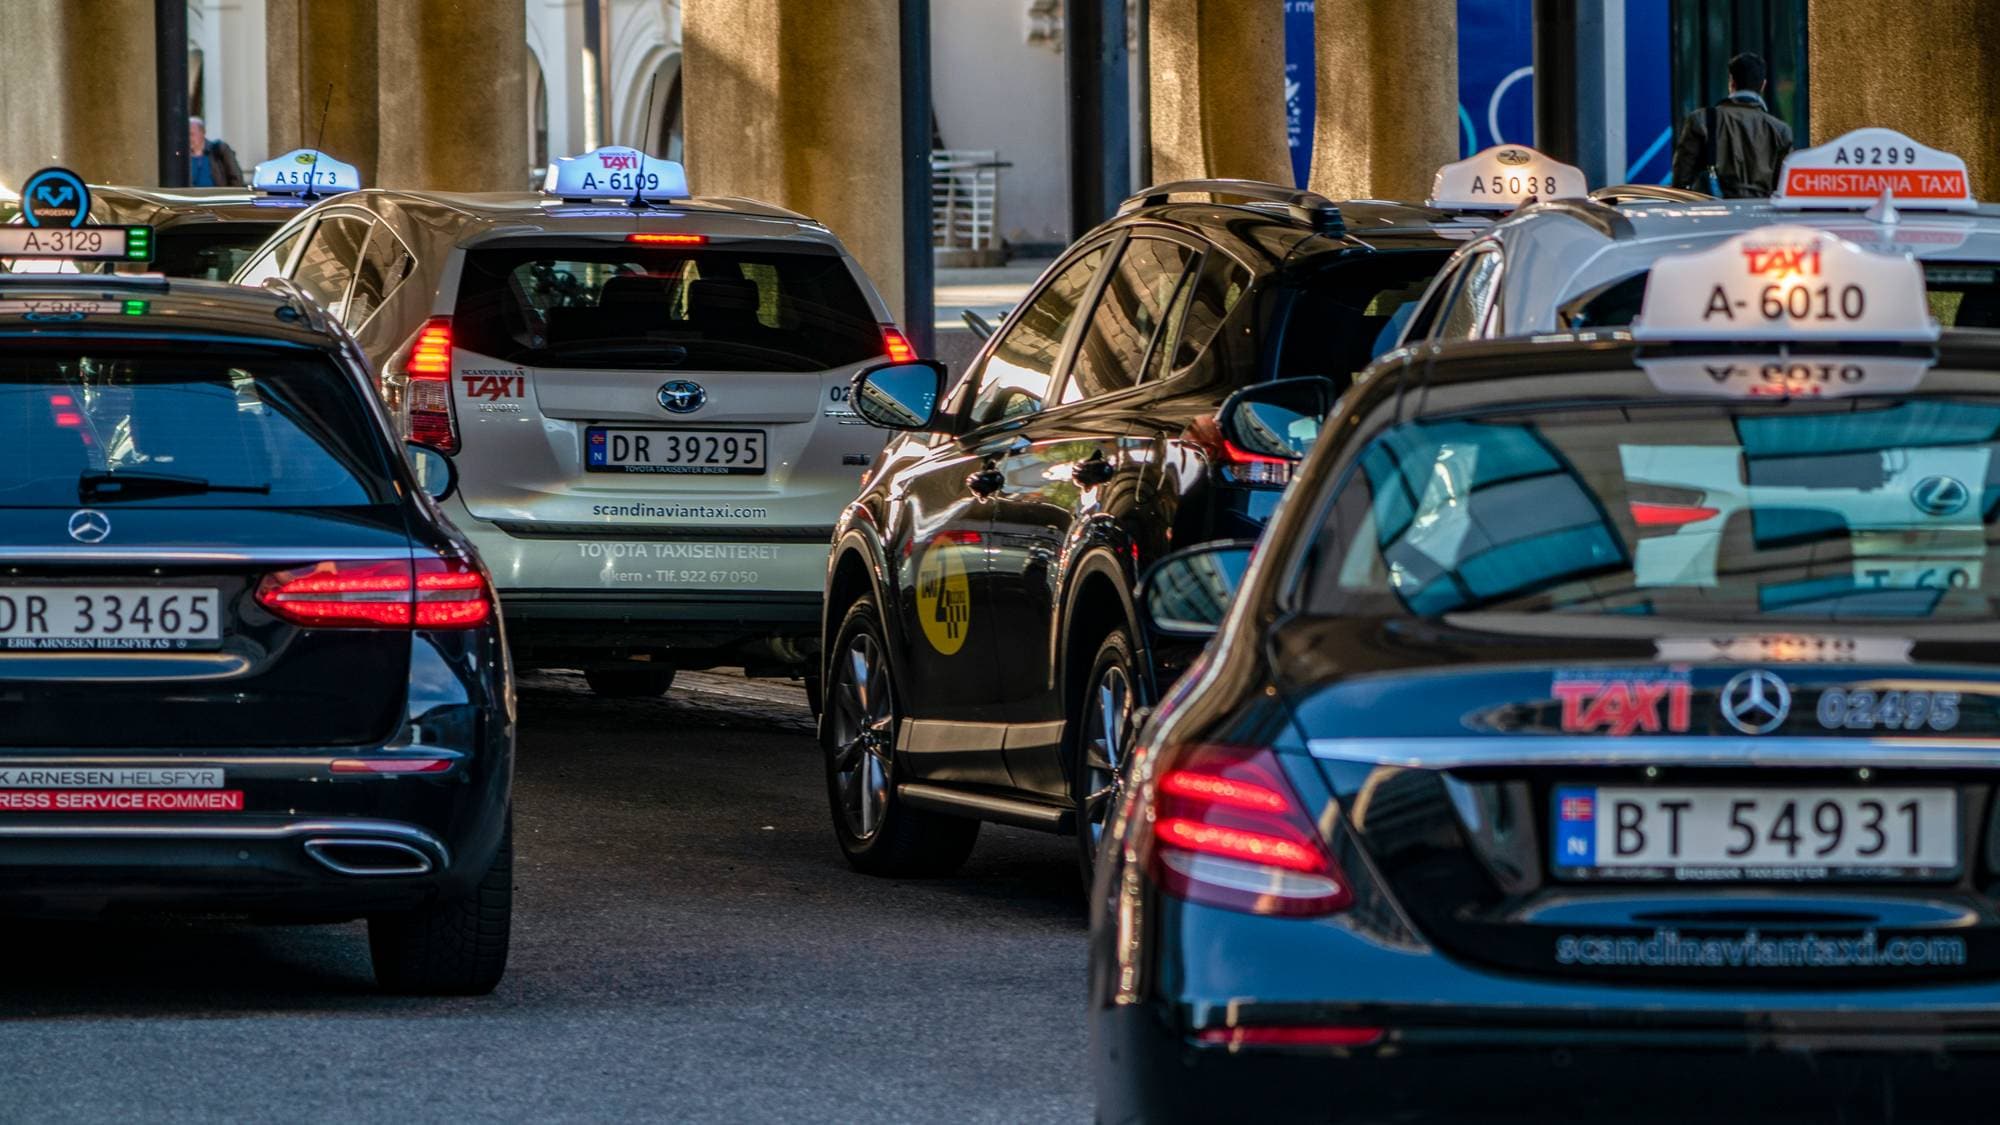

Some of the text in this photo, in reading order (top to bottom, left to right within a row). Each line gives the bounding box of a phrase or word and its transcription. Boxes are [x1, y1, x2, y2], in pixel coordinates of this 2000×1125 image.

[1835, 147, 1915, 164] A9299
[275, 171, 337, 184] A5073
[1471, 175, 1556, 195] A5038
[1791, 174, 1961, 193] CHRISTIANIA TAXI
[24, 231, 102, 252] A-3129
[461, 375, 525, 401] TAXI
[612, 434, 758, 464] DR 39295
[625, 465, 655, 473] TOYOTA
[593, 503, 767, 519] scandinaviantaxi.com
[577, 543, 781, 560] TOYOTA TAXISENTERET
[656, 570, 677, 583] Tlf.
[680, 571, 706, 583] 922
[74, 595, 209, 633] 33465
[7, 638, 170, 649] ERIK ARNESEN HELSFYR AS
[1552, 681, 1691, 735] TAXI
[1816, 688, 1961, 731] 02495
[15, 772, 113, 785] ARNESEN
[120, 772, 215, 785] HELSFYR
[55, 793, 144, 808] SERVICE
[147, 793, 237, 808] ROMMEN
[1613, 800, 1920, 858] BT 54931
[1555, 928, 1965, 966] scandinaviantaxi.com
